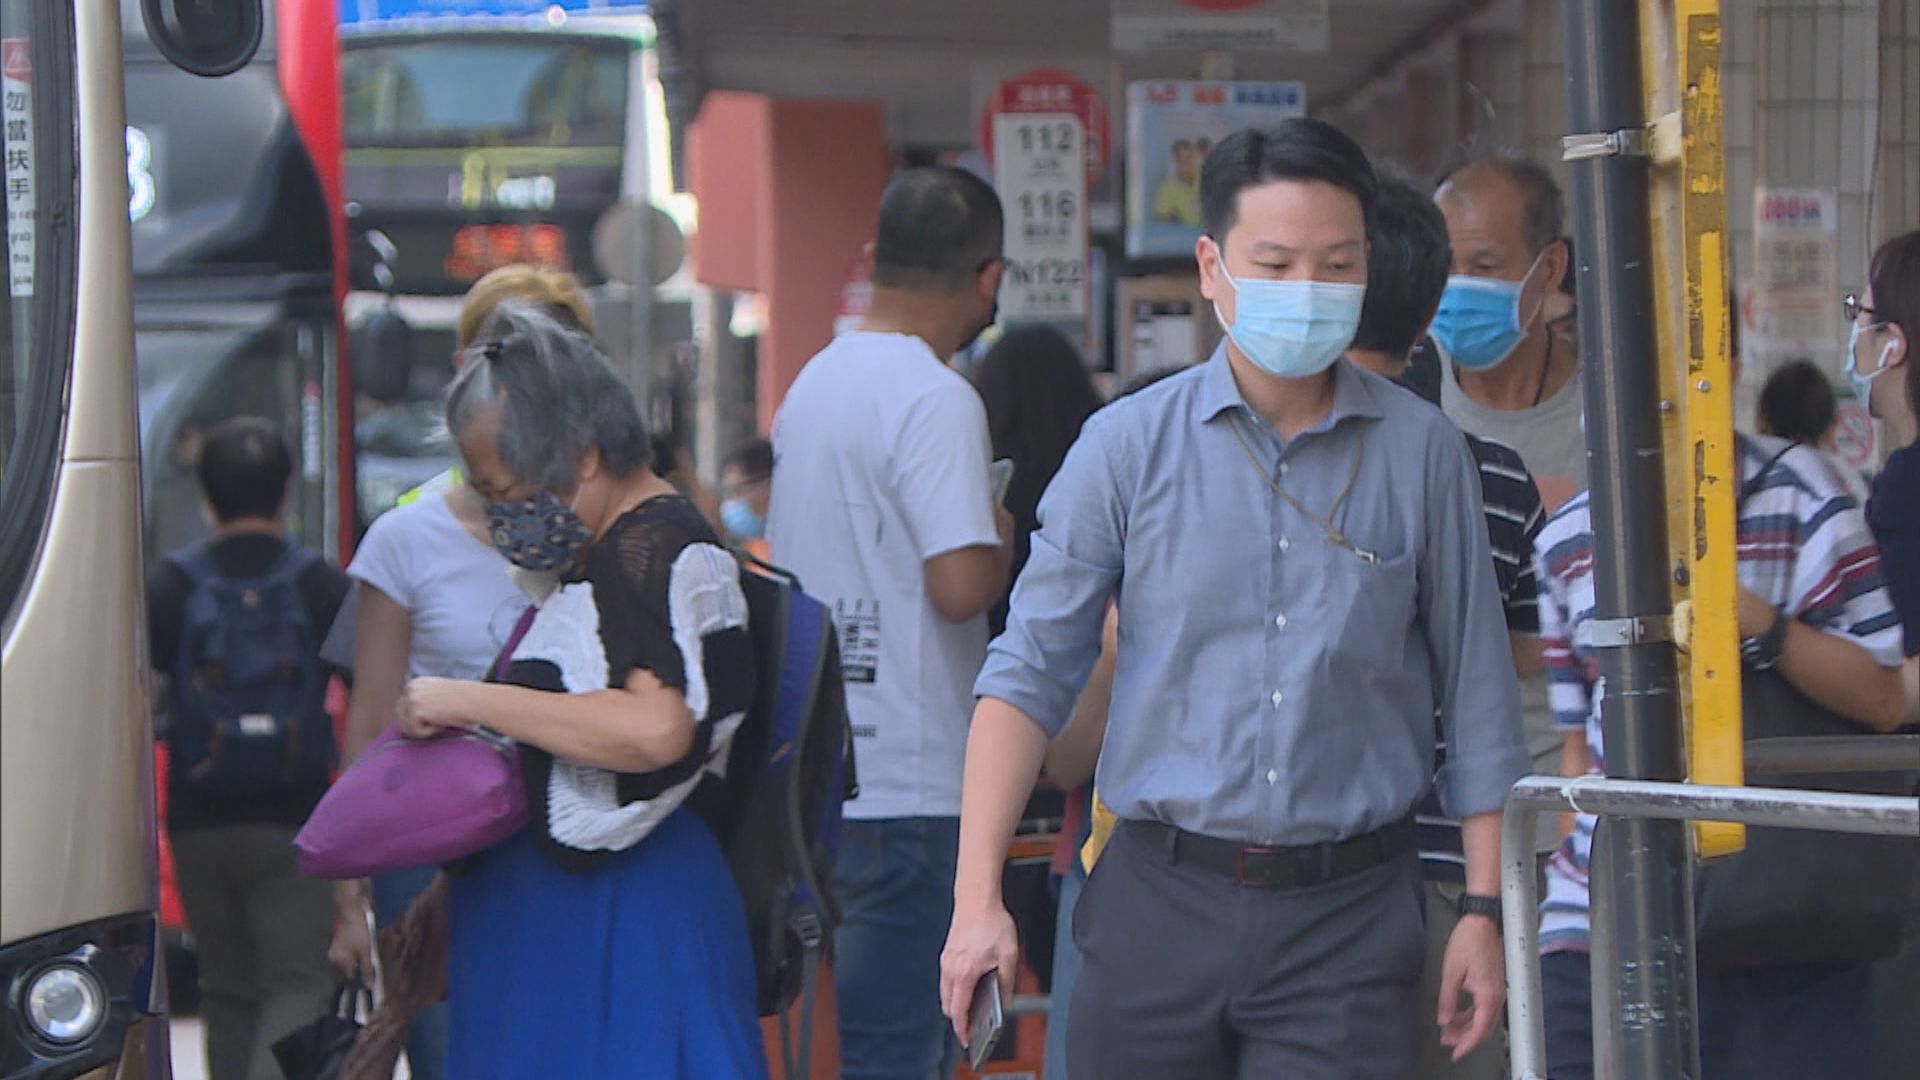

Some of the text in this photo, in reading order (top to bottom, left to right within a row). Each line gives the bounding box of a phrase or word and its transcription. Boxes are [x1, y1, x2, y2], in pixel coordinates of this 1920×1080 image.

[7, 90, 29, 200] 勿當扶手
[1016, 124, 1075, 153] 112
[1018, 190, 1077, 220] 116
